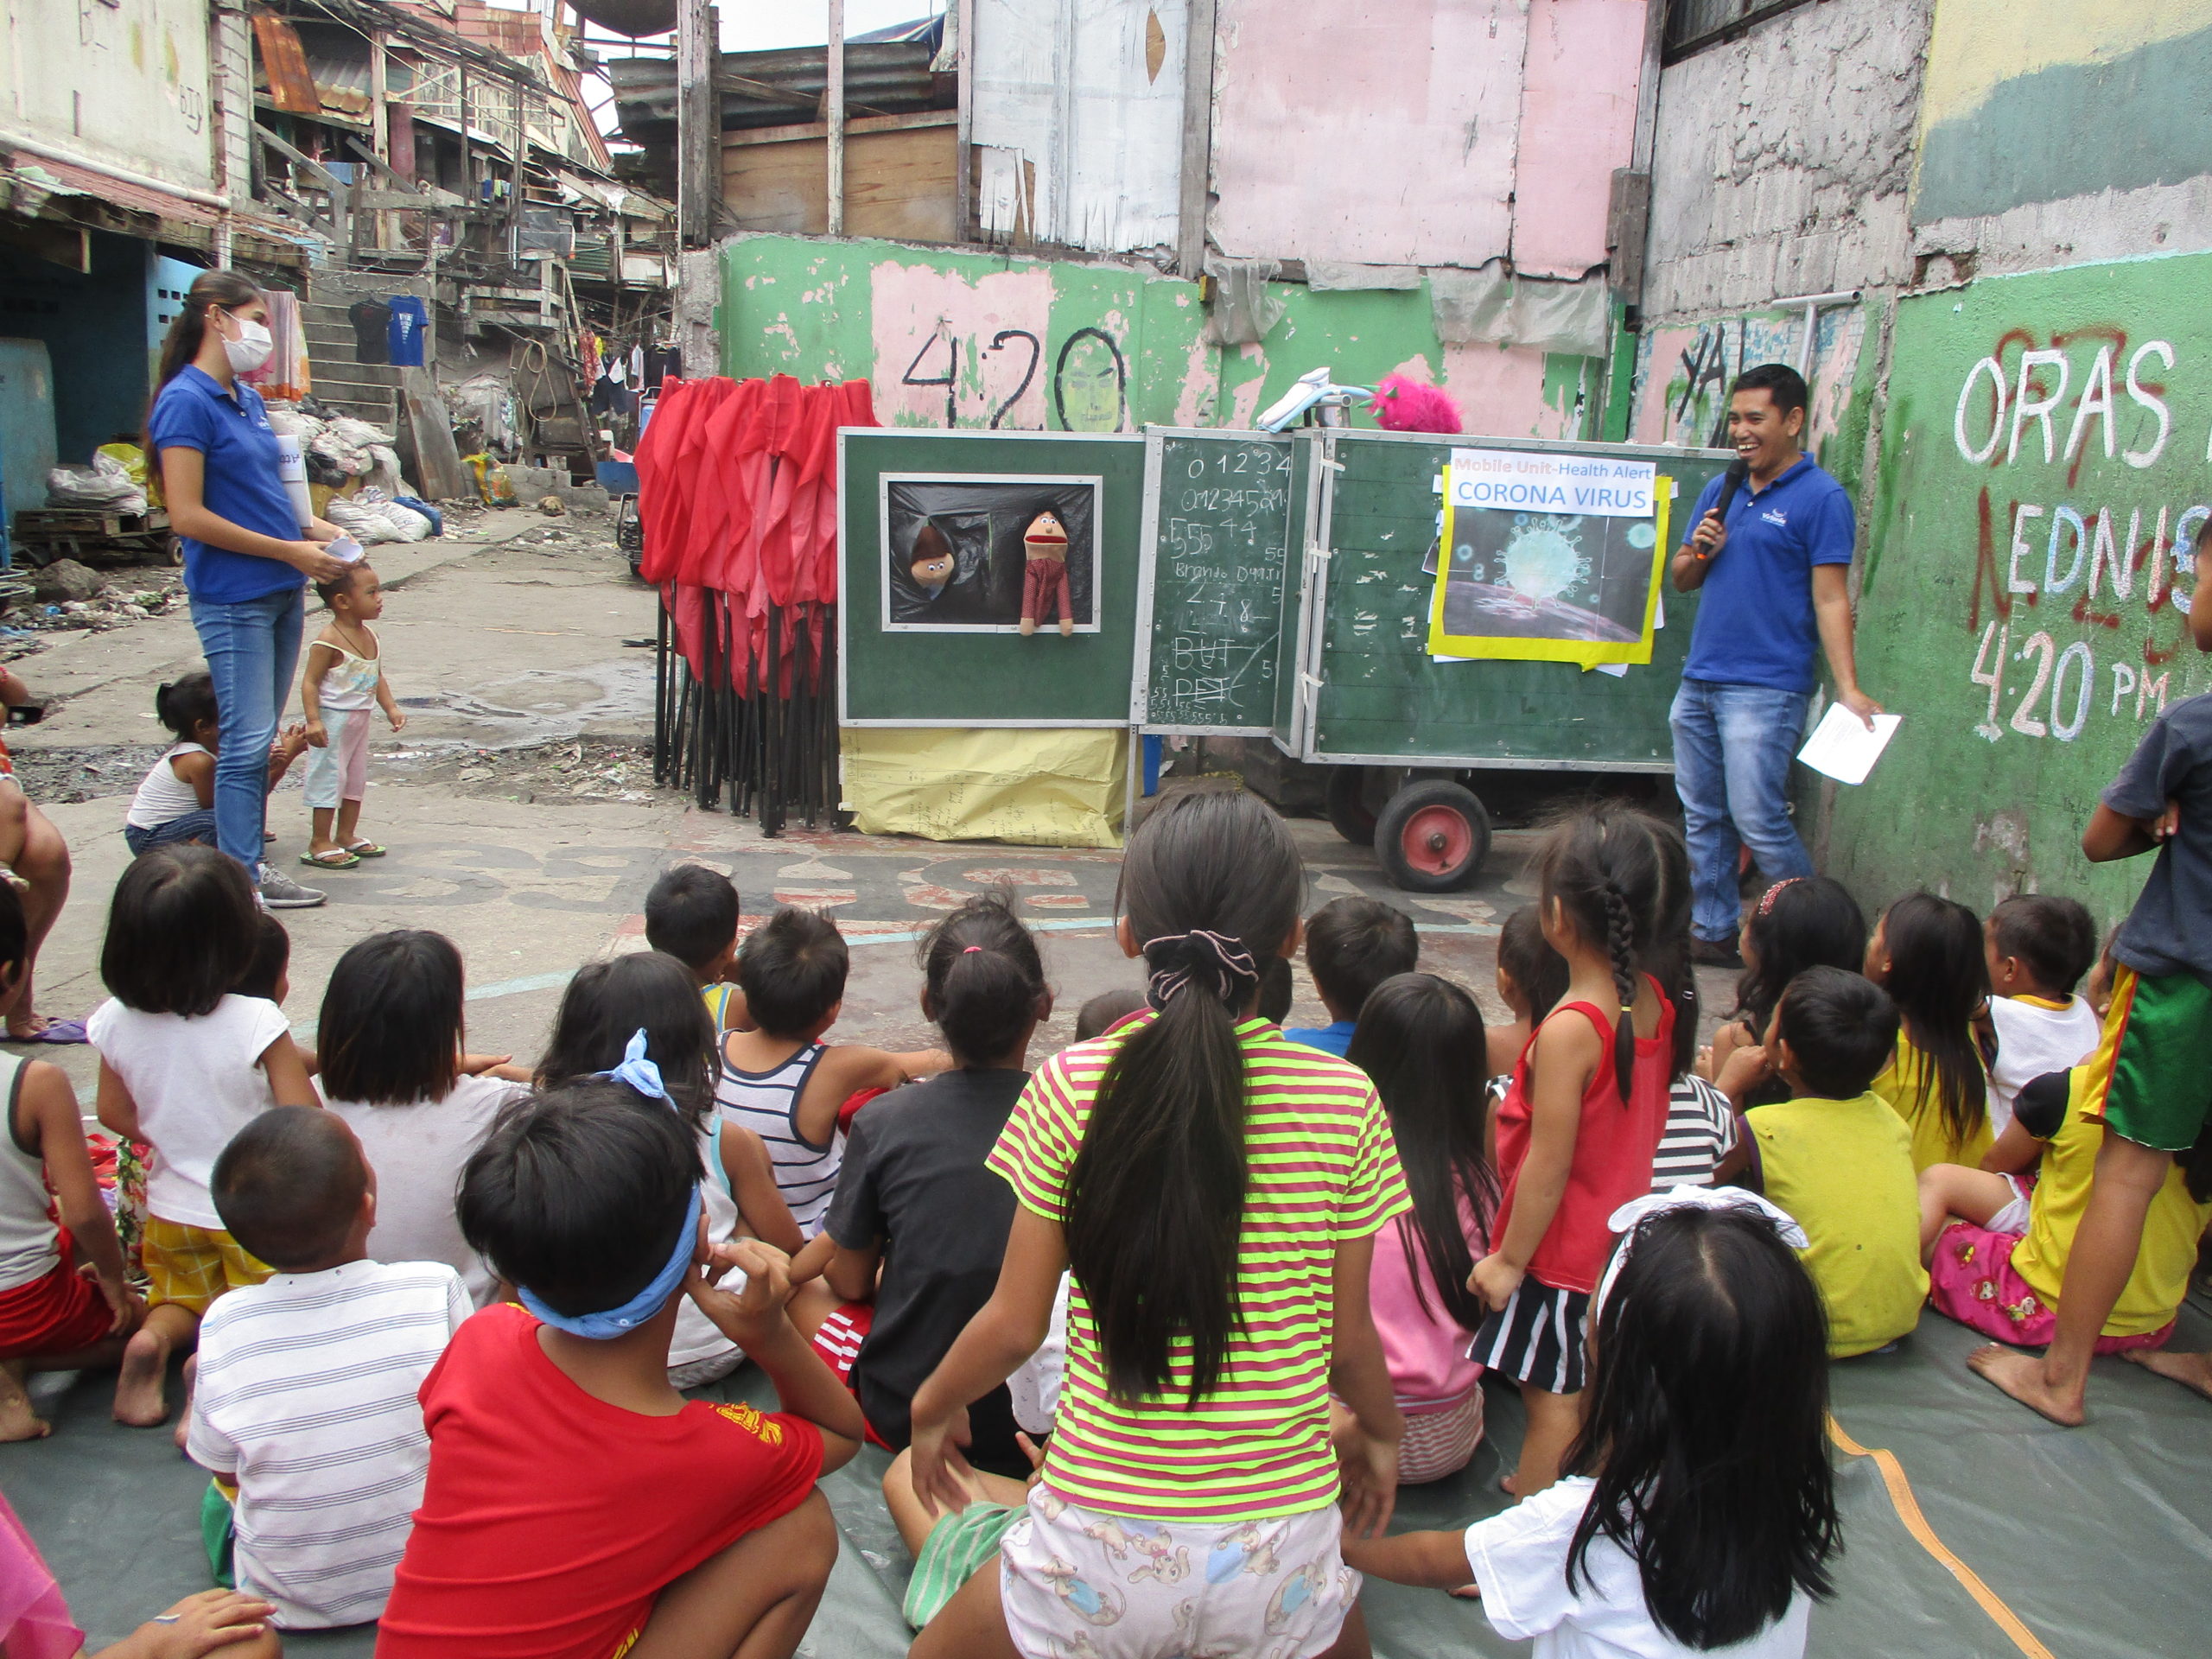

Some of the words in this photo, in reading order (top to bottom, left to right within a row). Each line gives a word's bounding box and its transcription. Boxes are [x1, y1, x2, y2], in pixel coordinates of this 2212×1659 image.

[1955, 340, 2176, 468] ORAS
[1454, 458, 1511, 474] Mobile
[1613, 463, 1651, 480] Alert
[1458, 480, 1566, 505] CORONA
[1575, 486, 1647, 509] VIRUS
[1971, 620, 2094, 742] 4:20
[2112, 662, 2171, 720] PM
